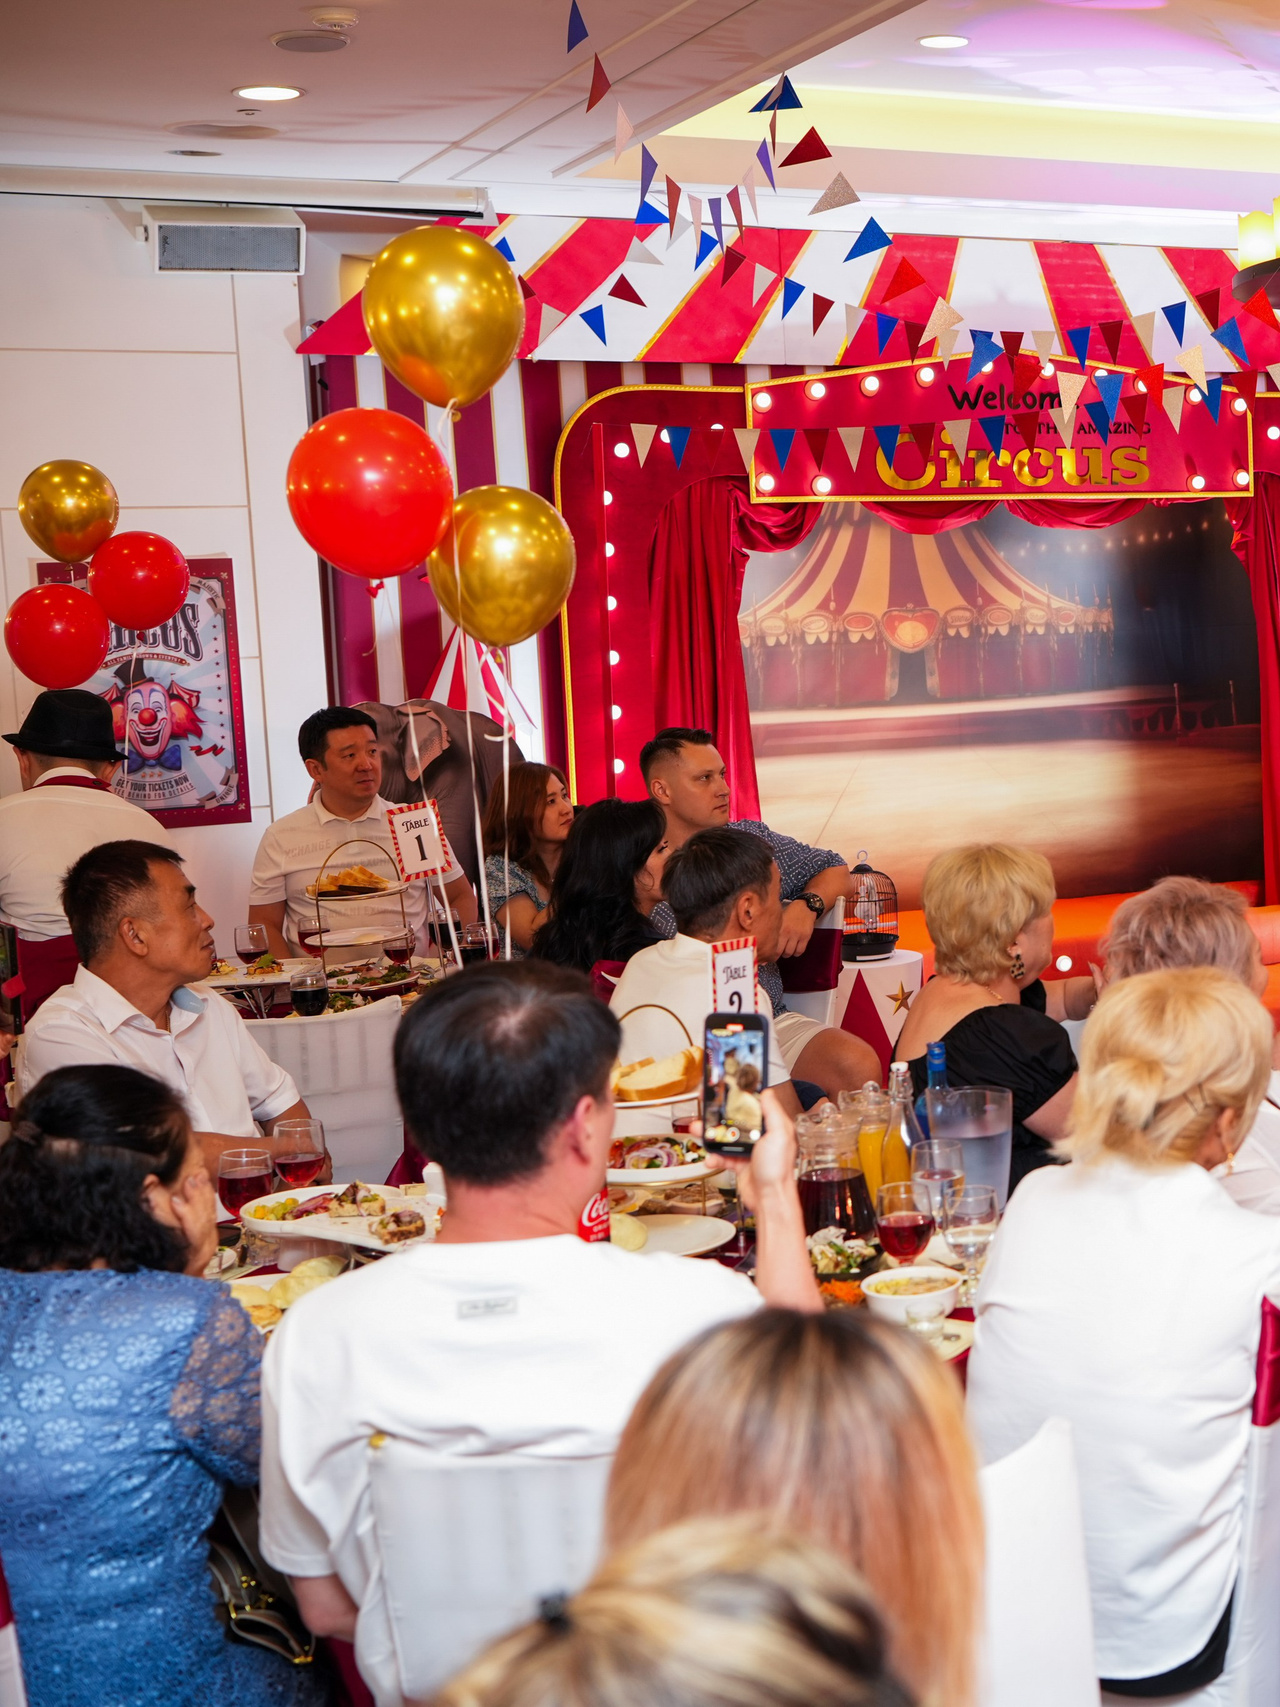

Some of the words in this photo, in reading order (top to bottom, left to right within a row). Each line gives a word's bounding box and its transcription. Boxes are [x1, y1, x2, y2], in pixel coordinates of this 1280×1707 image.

[947, 383, 1080, 411] Welcom
[1038, 422, 1059, 435] TH
[875, 429, 1150, 490] Circus
[116, 778, 129, 789] GET
[130, 781, 147, 792] YOUR
[148, 780, 174, 792] TICKETS
[174, 773, 190, 786] NOW
[128, 790, 151, 799] BEHIND
[154, 791, 166, 799] FOR
[168, 782, 194, 796] DETAILS
[401, 817, 430, 833] TABLE
[284, 839, 331, 859] XCHANGE
[415, 834, 428, 861] 1
[722, 965, 747, 985] TABLE
